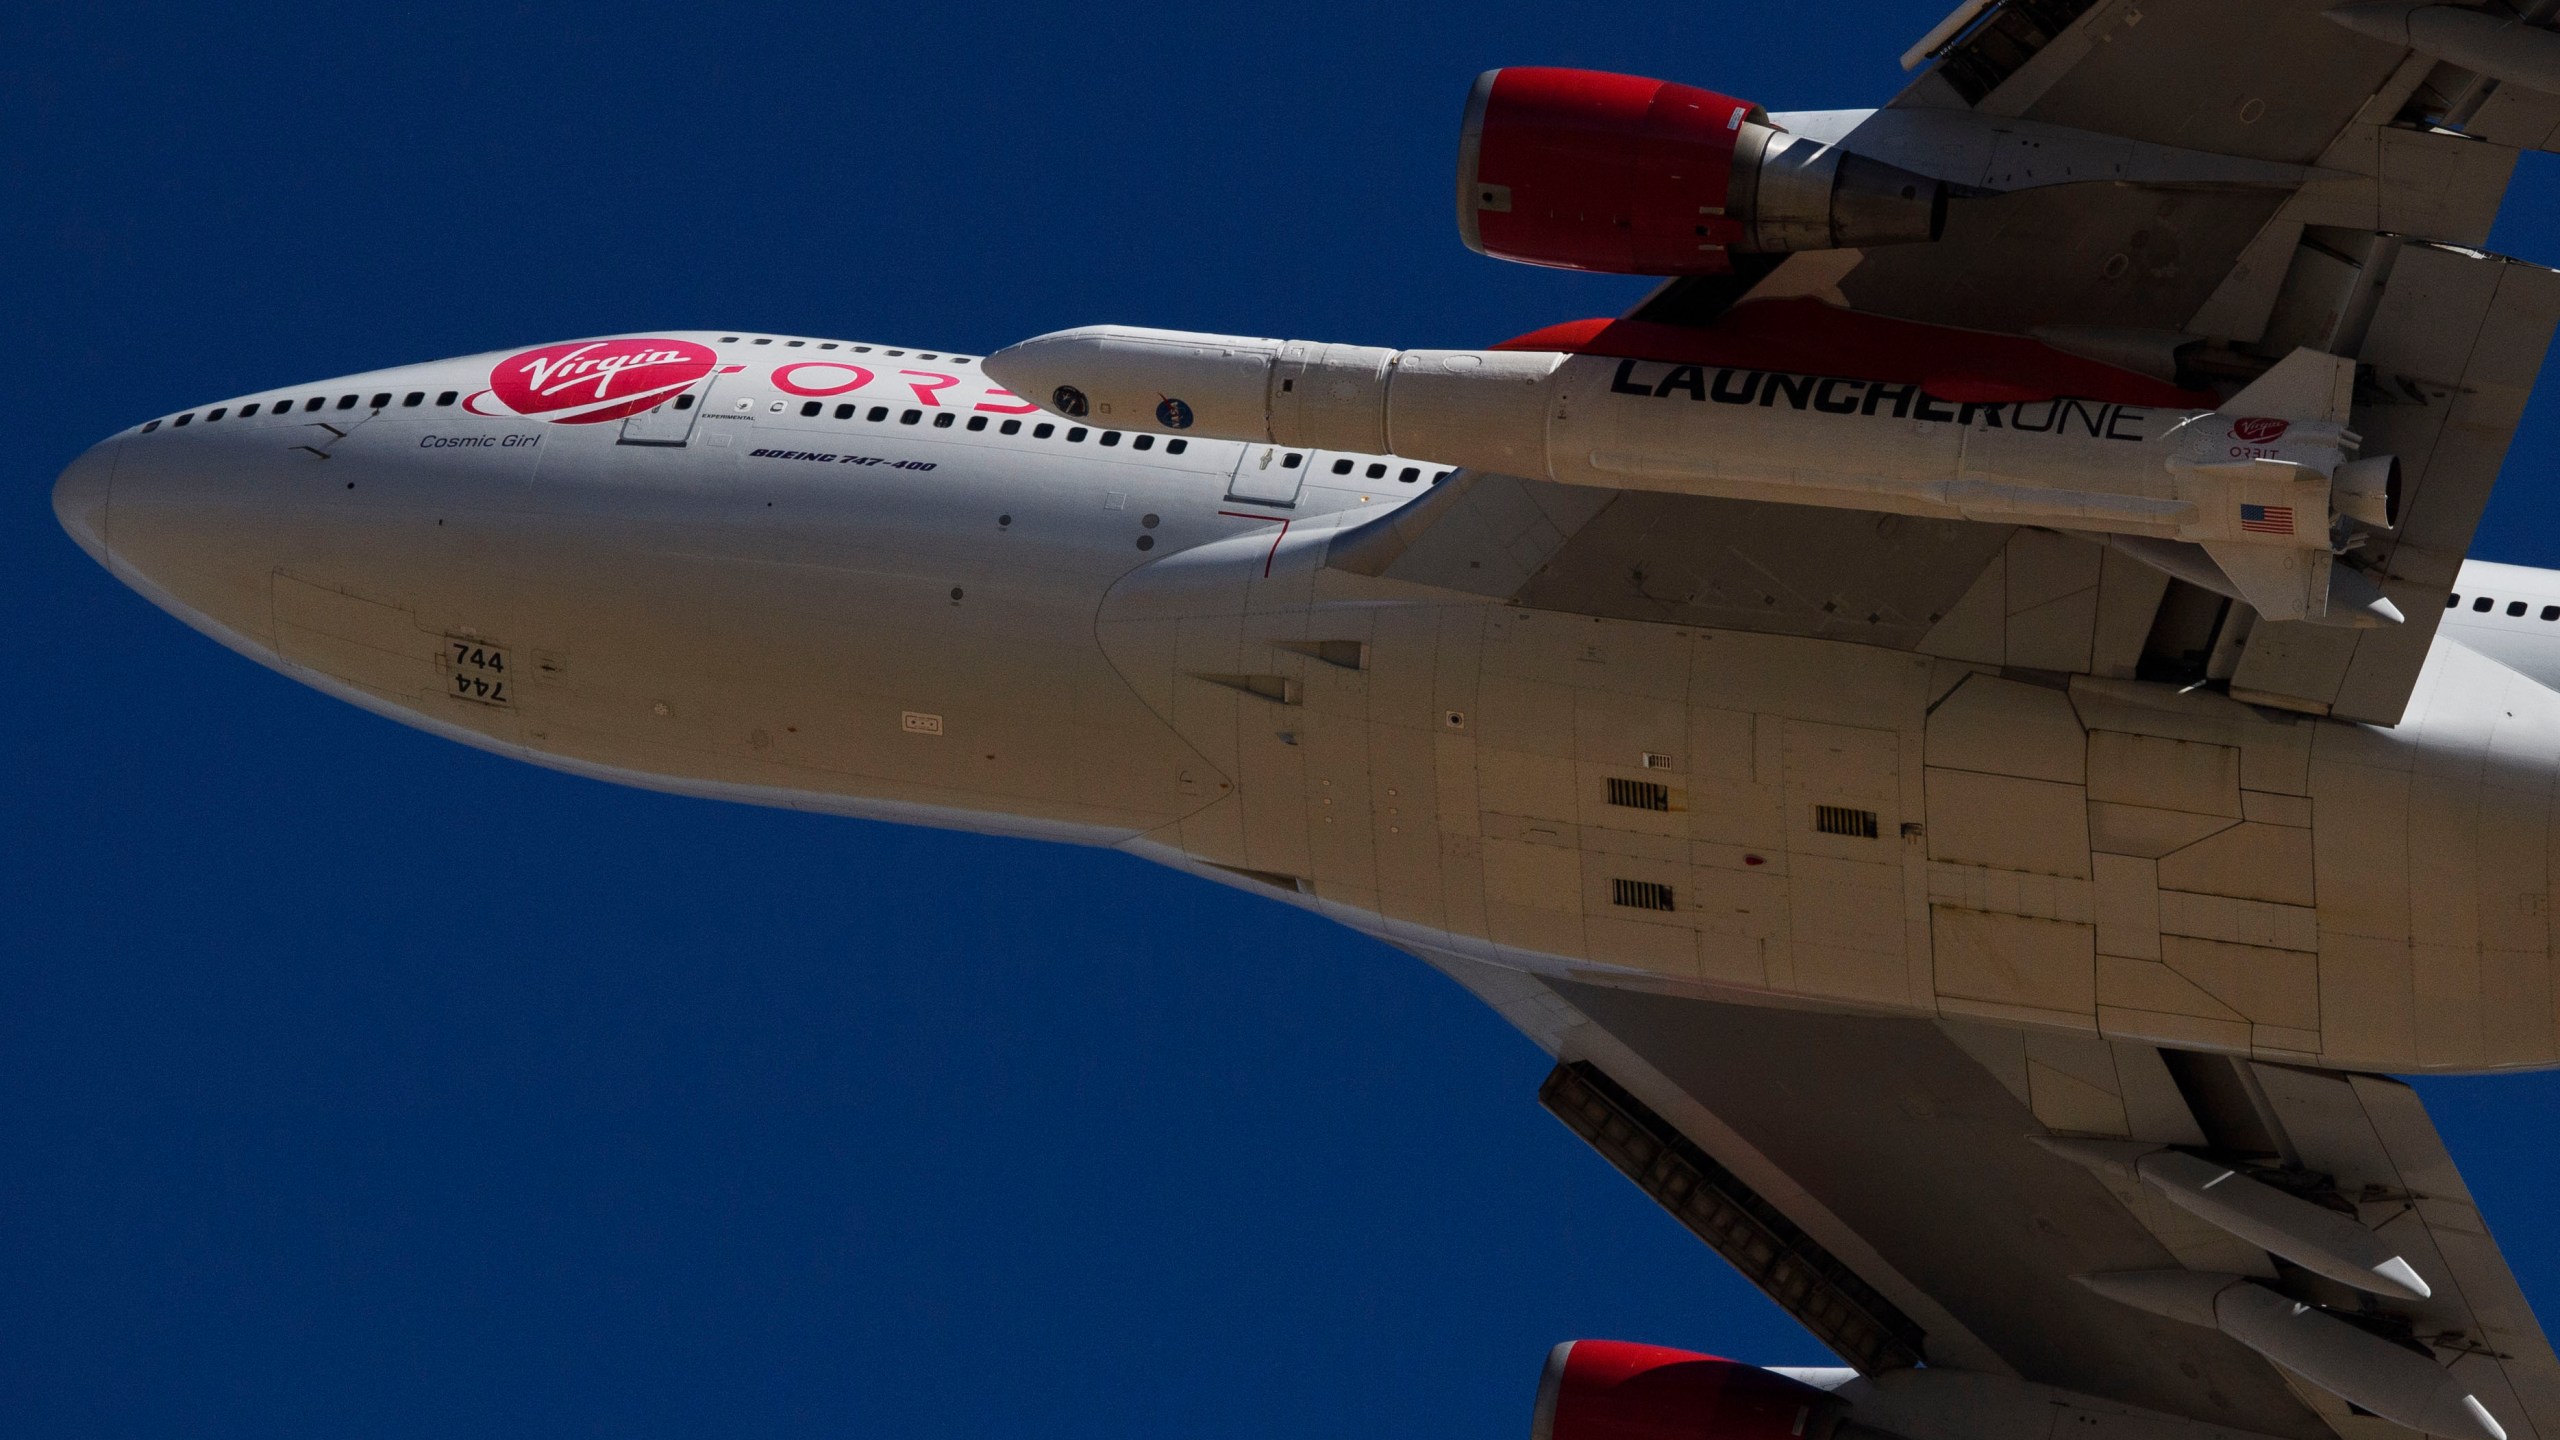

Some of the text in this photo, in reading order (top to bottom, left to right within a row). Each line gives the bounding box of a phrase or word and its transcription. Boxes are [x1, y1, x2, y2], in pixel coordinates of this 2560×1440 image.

[520, 343, 692, 398] Virgin
[702, 413, 754, 421] EXPERIMENTAL
[2241, 419, 2284, 437] Virgin
[420, 433, 541, 449] Cosmic Girl
[749, 448, 937, 472] BOEING 747-400
[2229, 446, 2279, 460] ORBIT
[453, 643, 504, 673] 744
[455, 673, 506, 702] 744
